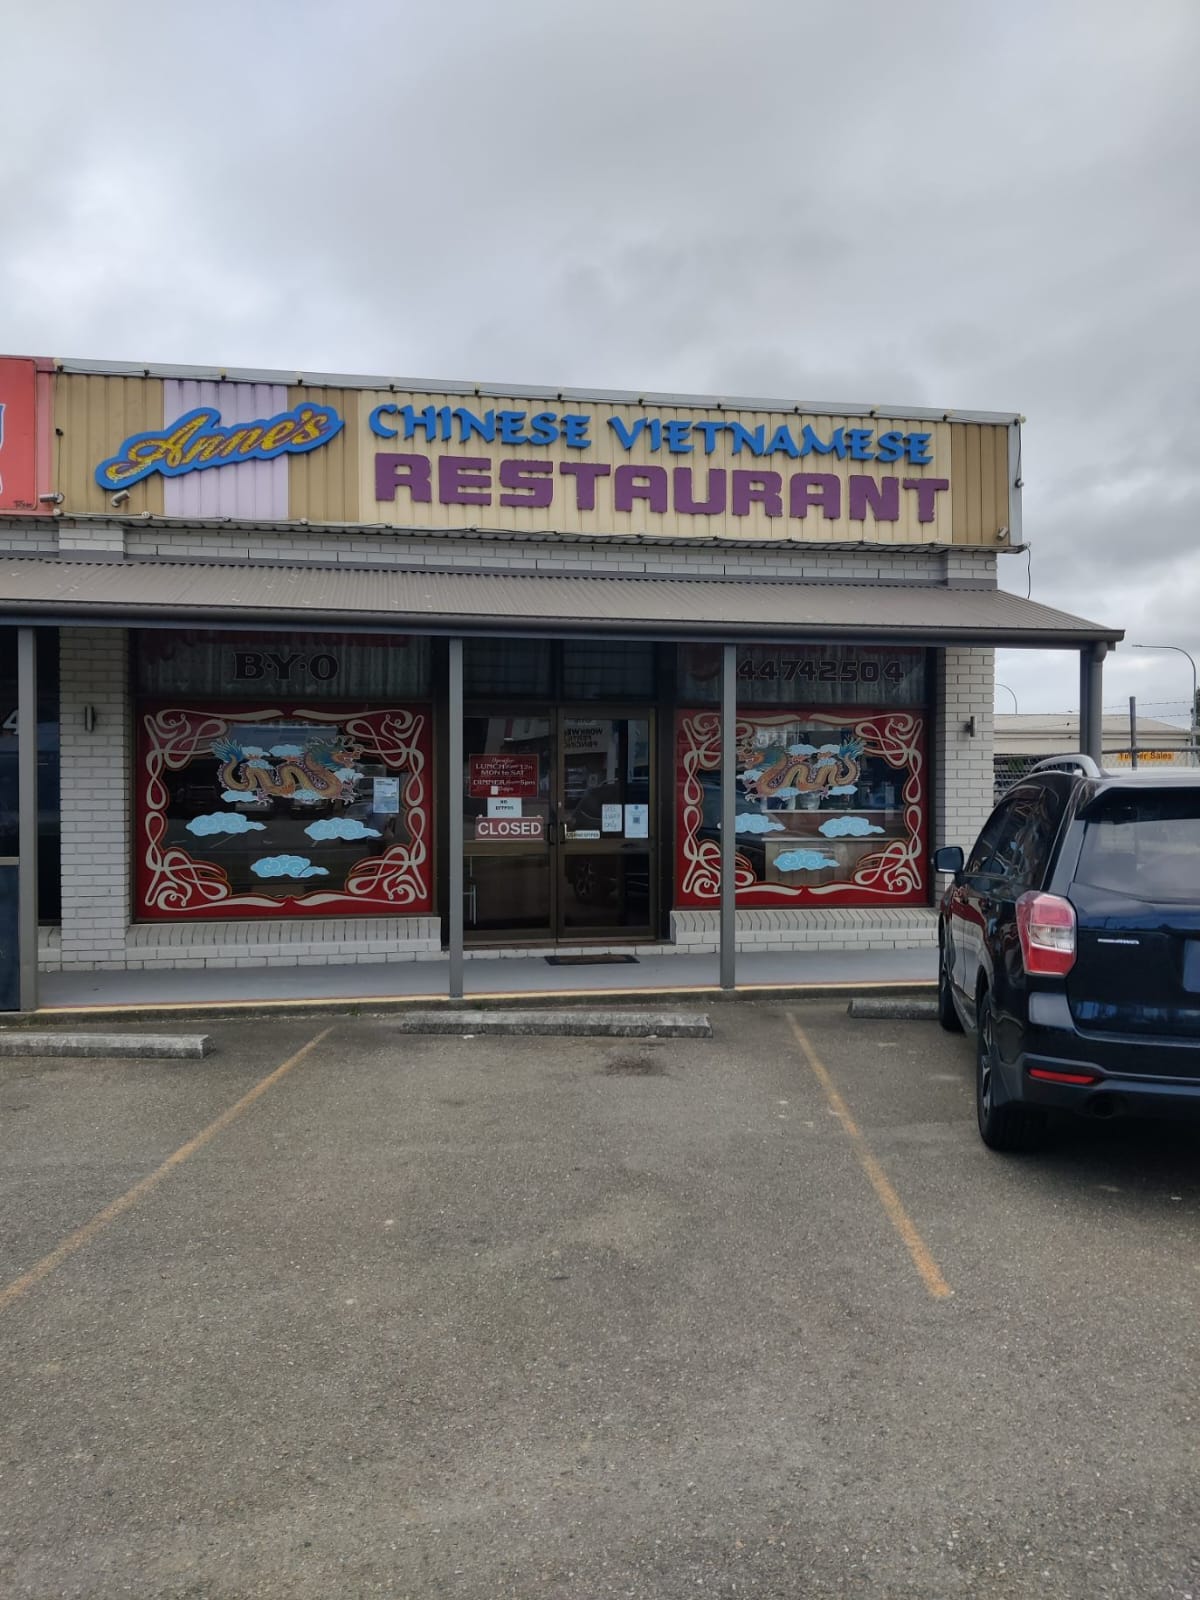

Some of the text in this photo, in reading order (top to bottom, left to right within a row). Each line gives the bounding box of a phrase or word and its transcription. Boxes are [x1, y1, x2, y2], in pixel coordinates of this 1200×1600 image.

[104, 408, 331, 482] Anne's
[369, 404, 933, 466] CHINESE VIETNAMESE
[374, 452, 950, 523] RESTAURANT
[1150, 751, 1173, 760] Sales
[478, 821, 541, 835] CLOSED
